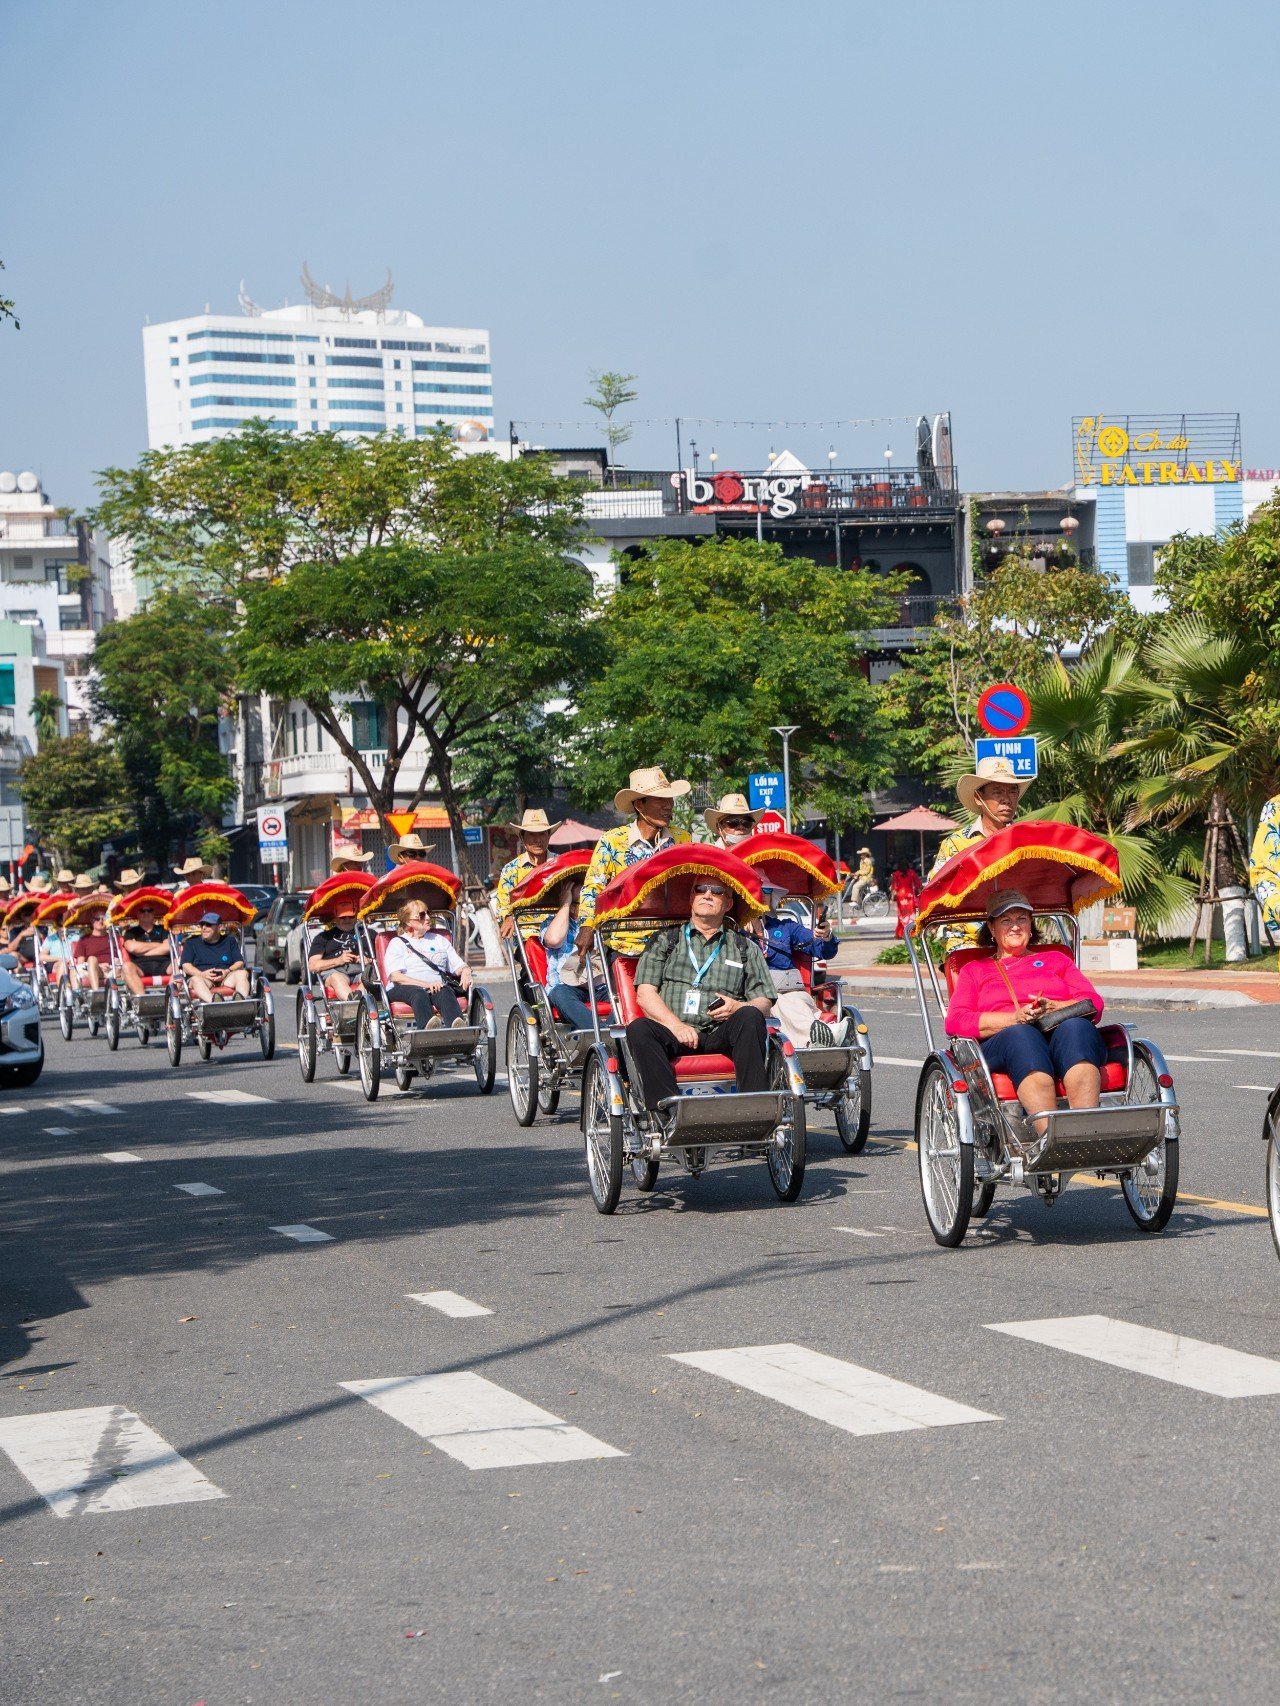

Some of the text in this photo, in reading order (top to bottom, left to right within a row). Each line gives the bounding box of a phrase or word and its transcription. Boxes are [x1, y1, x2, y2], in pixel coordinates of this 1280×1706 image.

[1101, 460, 1241, 485] FATRALY
[994, 742, 1022, 757] VỊNH
[1017, 759, 1032, 771] XE
[754, 775, 779, 787] LỐI RA
[759, 788, 774, 796] EXIT
[756, 821, 781, 833] STOP
